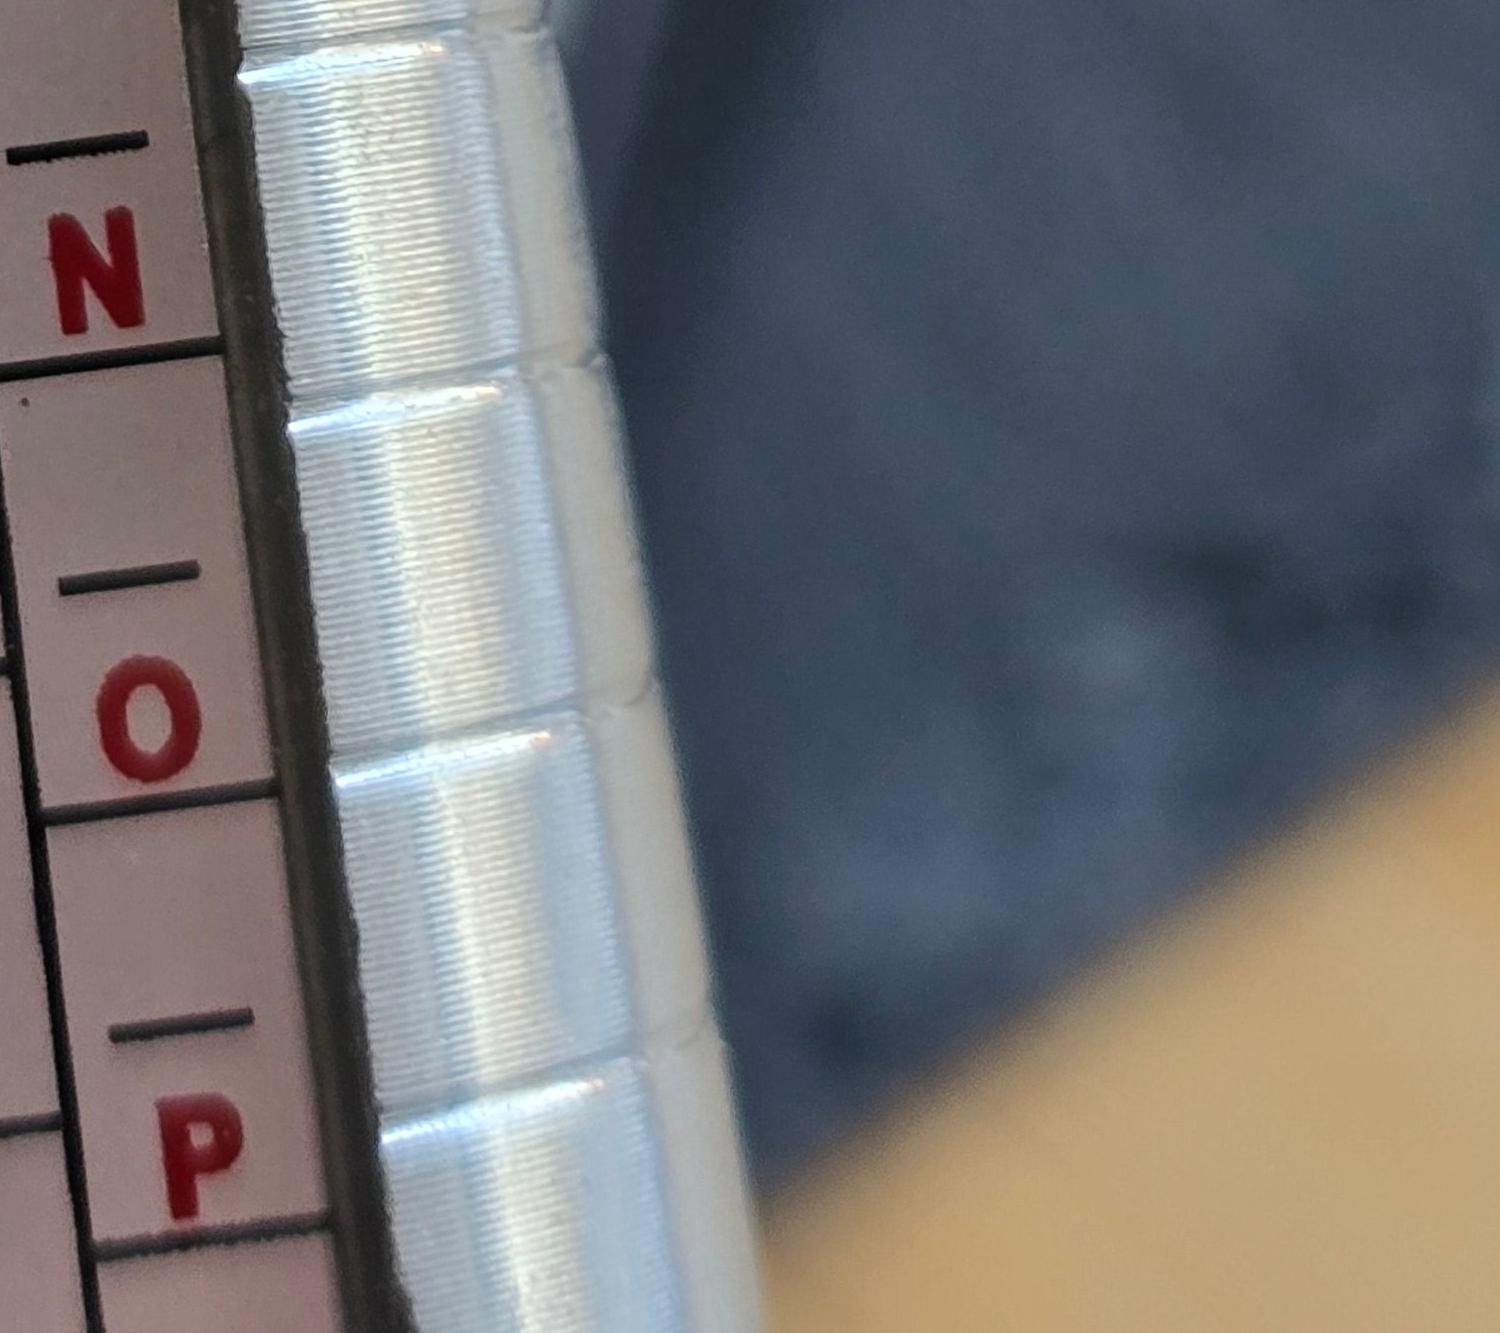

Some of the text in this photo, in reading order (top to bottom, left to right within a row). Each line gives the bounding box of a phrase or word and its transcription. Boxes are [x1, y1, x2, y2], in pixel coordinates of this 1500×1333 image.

[48, 203, 145, 336] N
[95, 655, 204, 787] O
[157, 1093, 243, 1227] P
